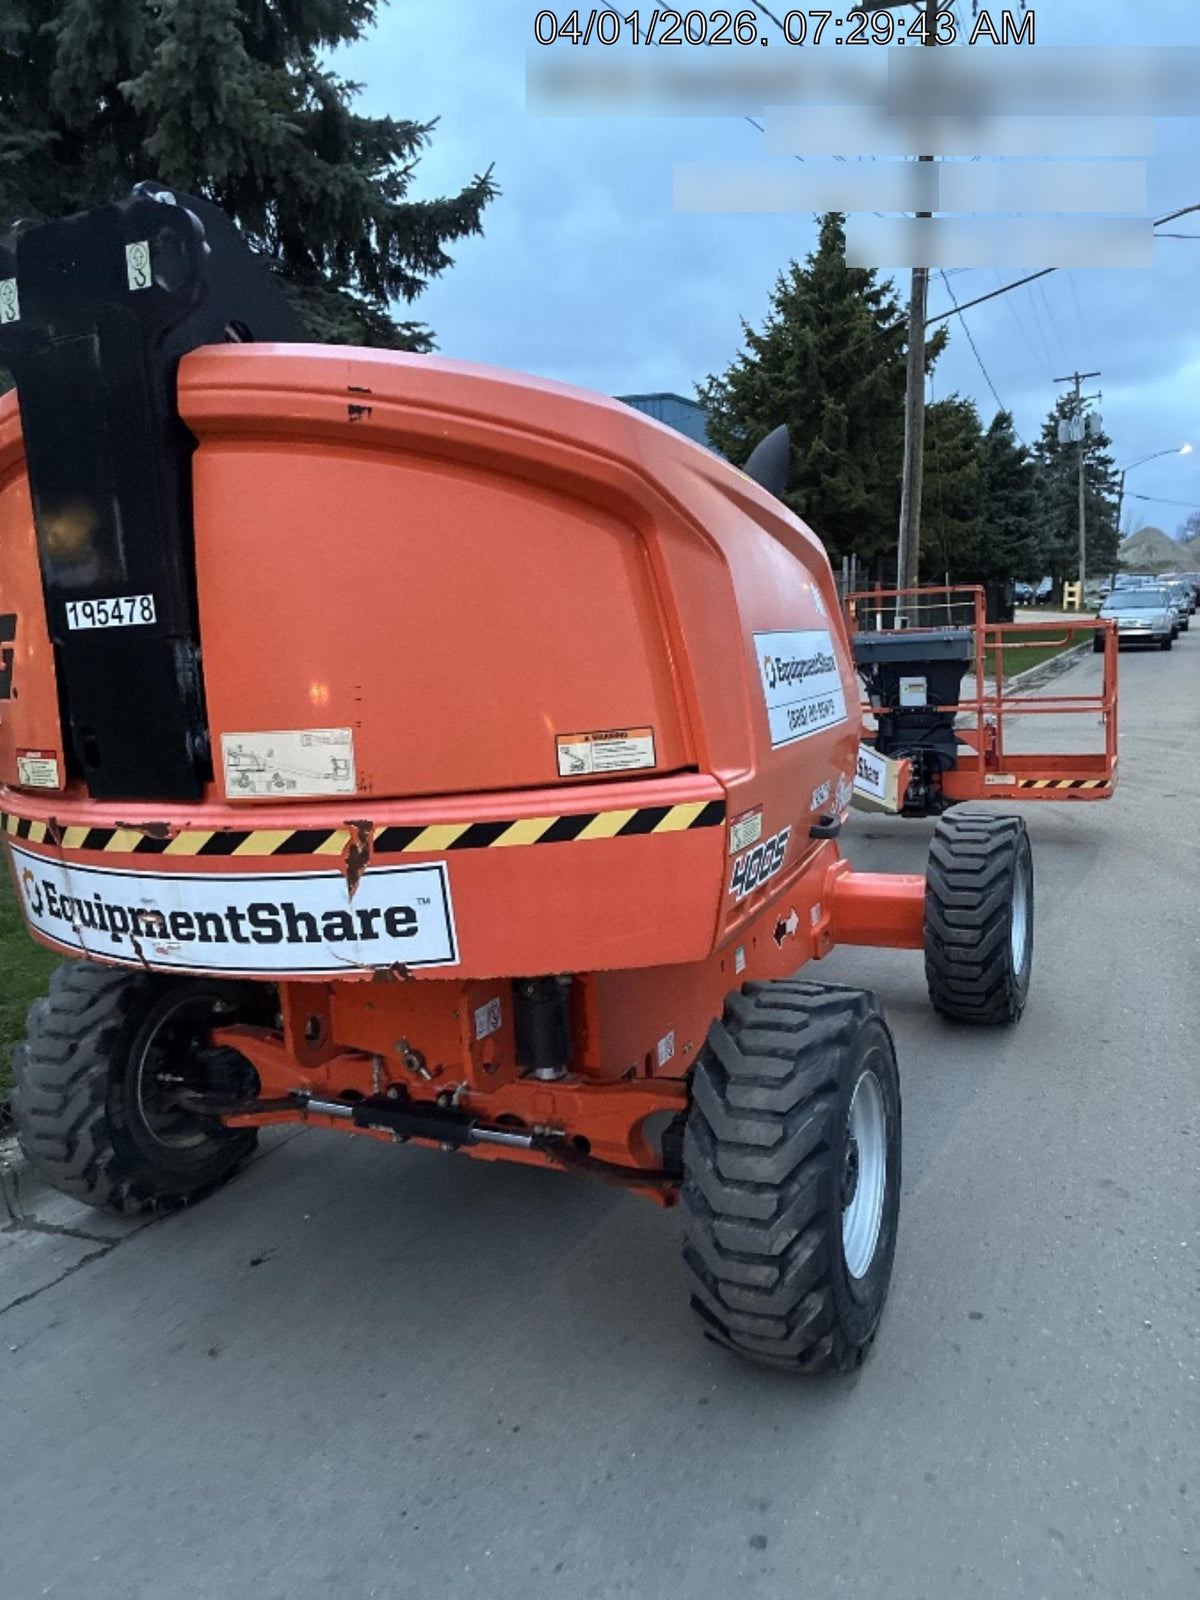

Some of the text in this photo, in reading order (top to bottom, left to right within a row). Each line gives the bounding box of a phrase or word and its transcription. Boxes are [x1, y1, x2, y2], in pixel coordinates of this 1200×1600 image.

[67, 596, 154, 627] 195478
[729, 825, 793, 900] 400S
[42, 880, 418, 943] EquipmentShare
